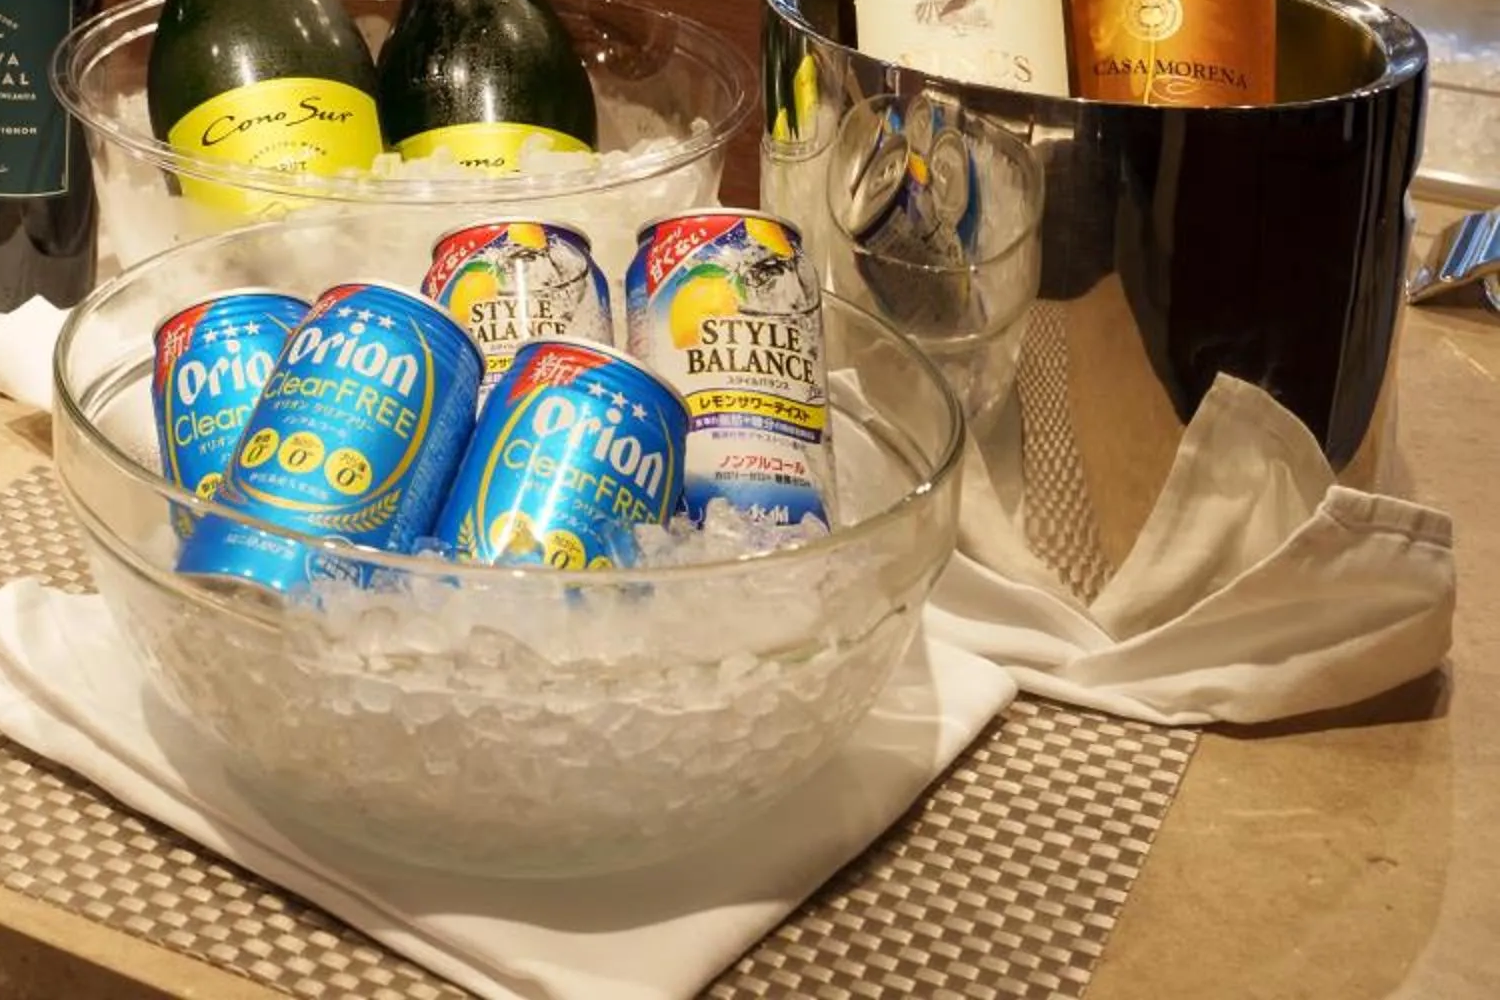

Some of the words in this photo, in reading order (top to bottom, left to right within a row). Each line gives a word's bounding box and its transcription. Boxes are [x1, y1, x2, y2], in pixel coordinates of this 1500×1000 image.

[1093, 57, 1148, 77] CASA
[1155, 58, 1250, 91] MORENA
[202, 115, 286, 146] Cono
[285, 96, 354, 126] Sur
[471, 299, 553, 323] STYE
[702, 318, 803, 354] STYLE
[178, 339, 270, 406] Orio
[287, 321, 419, 398] Orion
[687, 347, 815, 386] BALANCE
[700, 394, 811, 423] レモンサワーテイスト
[532, 395, 664, 499] Orion
[720, 455, 806, 476] ノンアルコール
